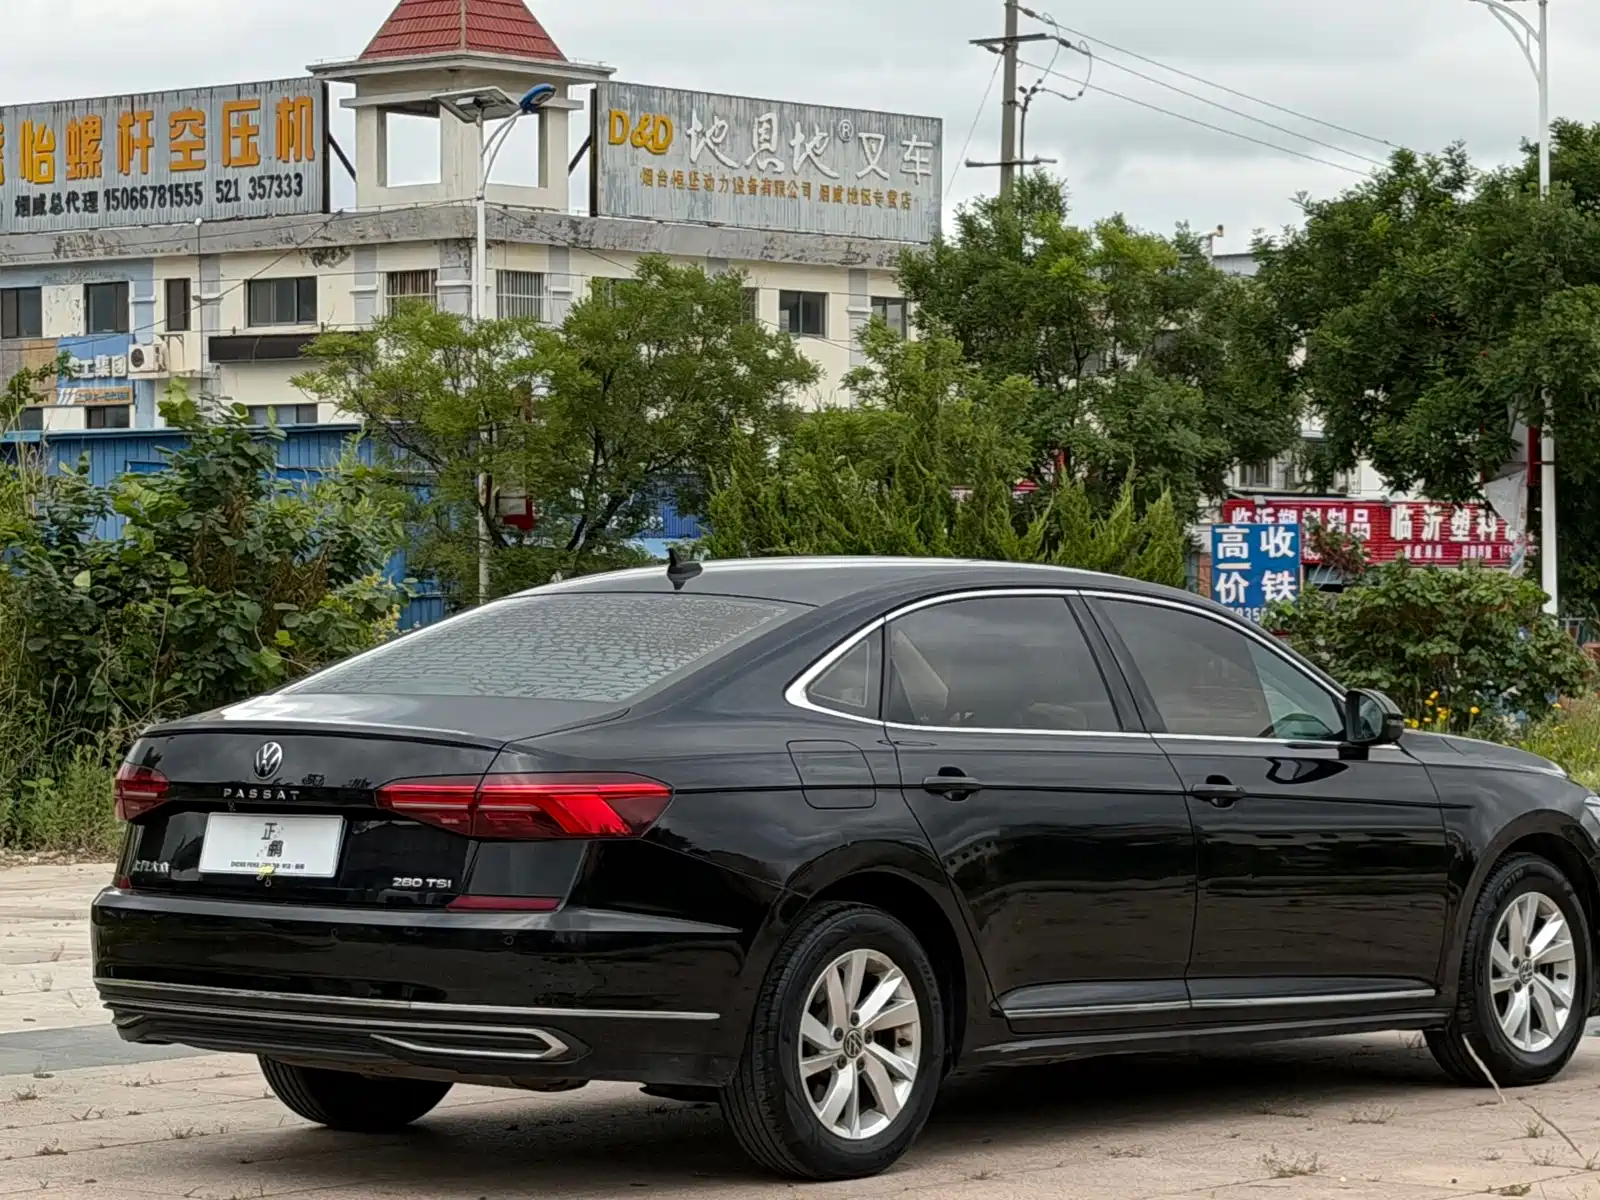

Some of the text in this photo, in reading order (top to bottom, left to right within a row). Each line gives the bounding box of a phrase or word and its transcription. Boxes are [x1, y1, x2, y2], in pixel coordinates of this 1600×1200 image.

[608, 107, 674, 155] D&D
[103, 181, 203, 212] 15066781555
[215, 178, 241, 203] 521
[247, 172, 304, 200] 357333
[223, 788, 300, 800] PASSAT
[391, 876, 453, 889] 280 TSI
